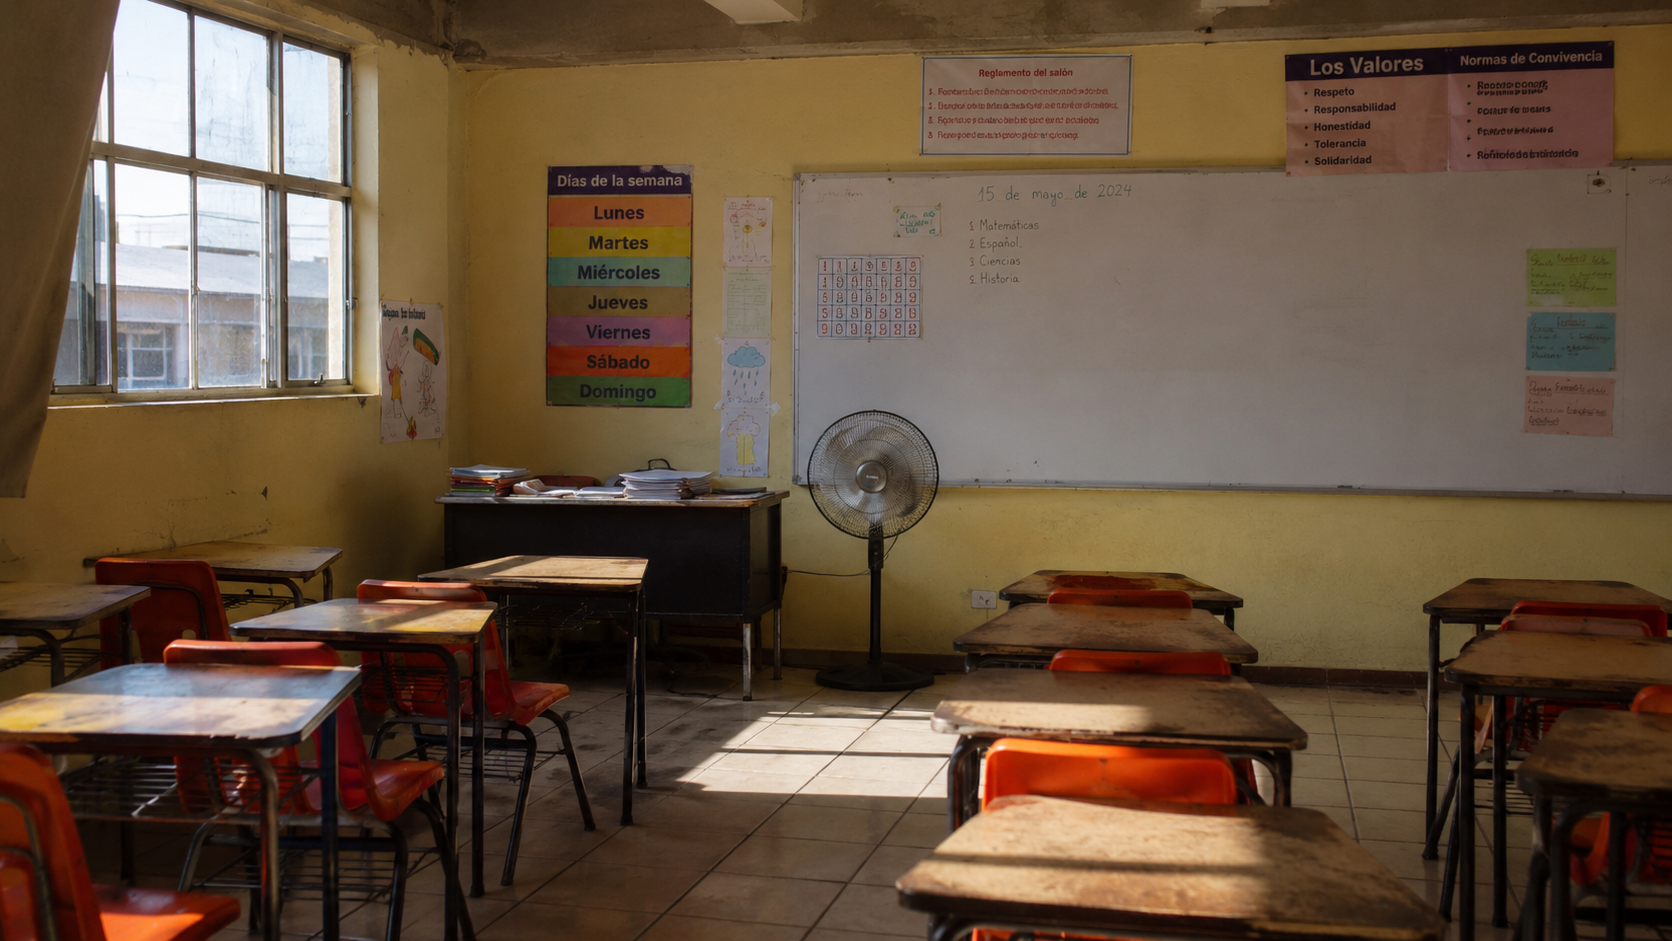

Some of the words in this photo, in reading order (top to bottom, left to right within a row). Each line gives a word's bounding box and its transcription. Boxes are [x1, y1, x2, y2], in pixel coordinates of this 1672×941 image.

[1310, 59, 1344, 76] Los
[1350, 56, 1424, 74] Valores
[1460, 54, 1506, 66] Normas
[1510, 53, 1526, 65] de
[979, 68, 1031, 79] Reglamento
[1033, 68, 1047, 77] del
[1049, 68, 1073, 77] salón
[1314, 87, 1355, 99] Respeto
[1314, 102, 1396, 116] Responsabilidad
[1314, 120, 1371, 132] Honestidad
[1314, 138, 1366, 149] Tolerancia
[1314, 155, 1372, 166] Solidaridad
[557, 174, 587, 187] Días
[590, 174, 608, 187] de
[612, 174, 624, 187] la
[628, 175, 683, 187] semana
[978, 185, 995, 202] 15
[1005, 185, 1020, 201] de
[1032, 191, 1064, 207] mayo
[1075, 184, 1088, 199] de
[1098, 184, 1132, 198] 2024
[594, 206, 645, 220] Lunes
[980, 219, 1039, 231] Matemáticas
[589, 236, 649, 250] Martes
[979, 254, 1021, 266] Ciencias
[577, 265, 661, 280] Miércoles
[980, 272, 1020, 284] Historia
[588, 295, 648, 310] Jueves
[586, 325, 651, 339] Viernes
[586, 354, 650, 369] Sábado
[580, 384, 656, 402] Domingo
